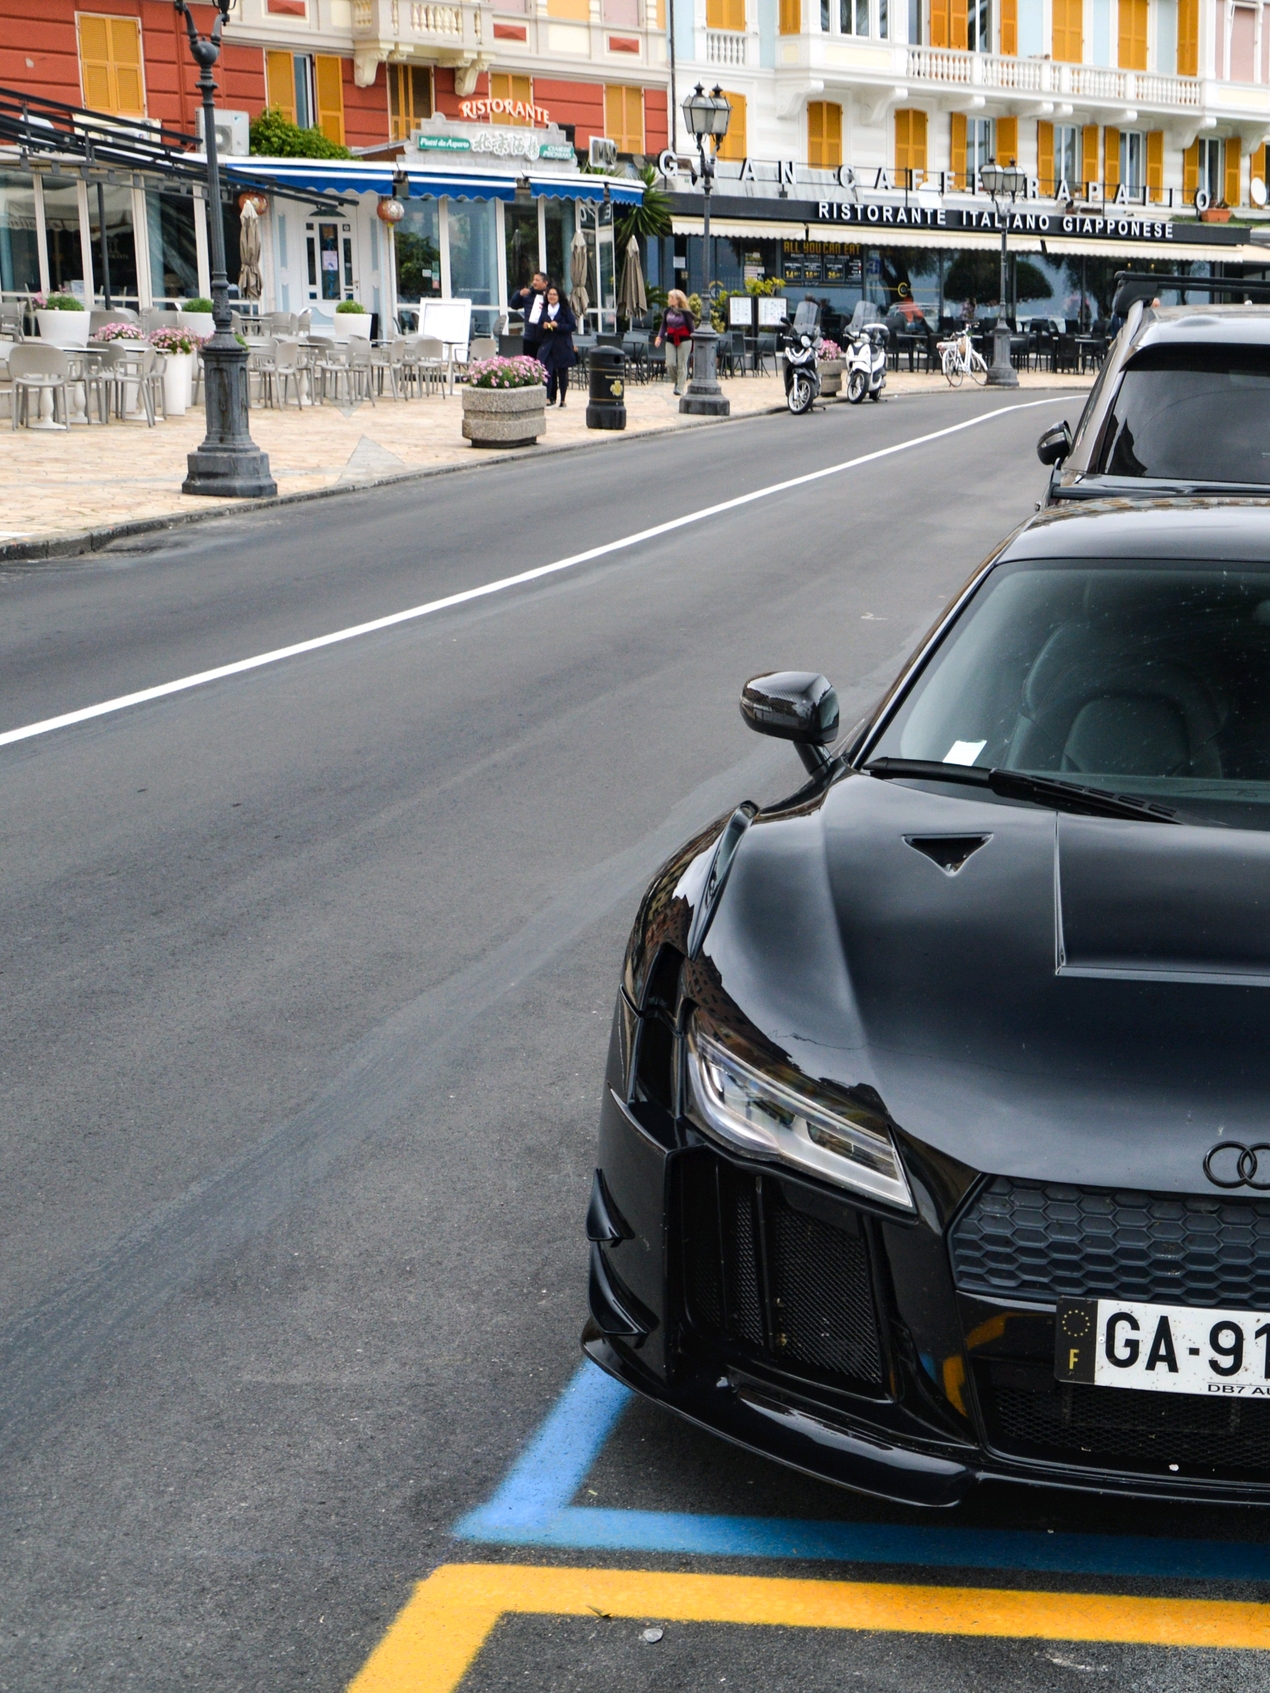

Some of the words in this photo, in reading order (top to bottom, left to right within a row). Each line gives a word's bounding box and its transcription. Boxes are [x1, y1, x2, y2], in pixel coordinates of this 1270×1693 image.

[461, 98, 551, 125] RISTORANTE
[658, 150, 799, 185] GAN
[1024, 177, 1210, 211] RAPALLO
[818, 201, 947, 225] RISTORANTE
[1062, 218, 1174, 239] GIAPPONESE
[783, 241, 800, 253] ALL
[843, 243, 861, 255] EAT
[1069, 1349, 1080, 1370] F
[1207, 1383, 1246, 1395] DB7
